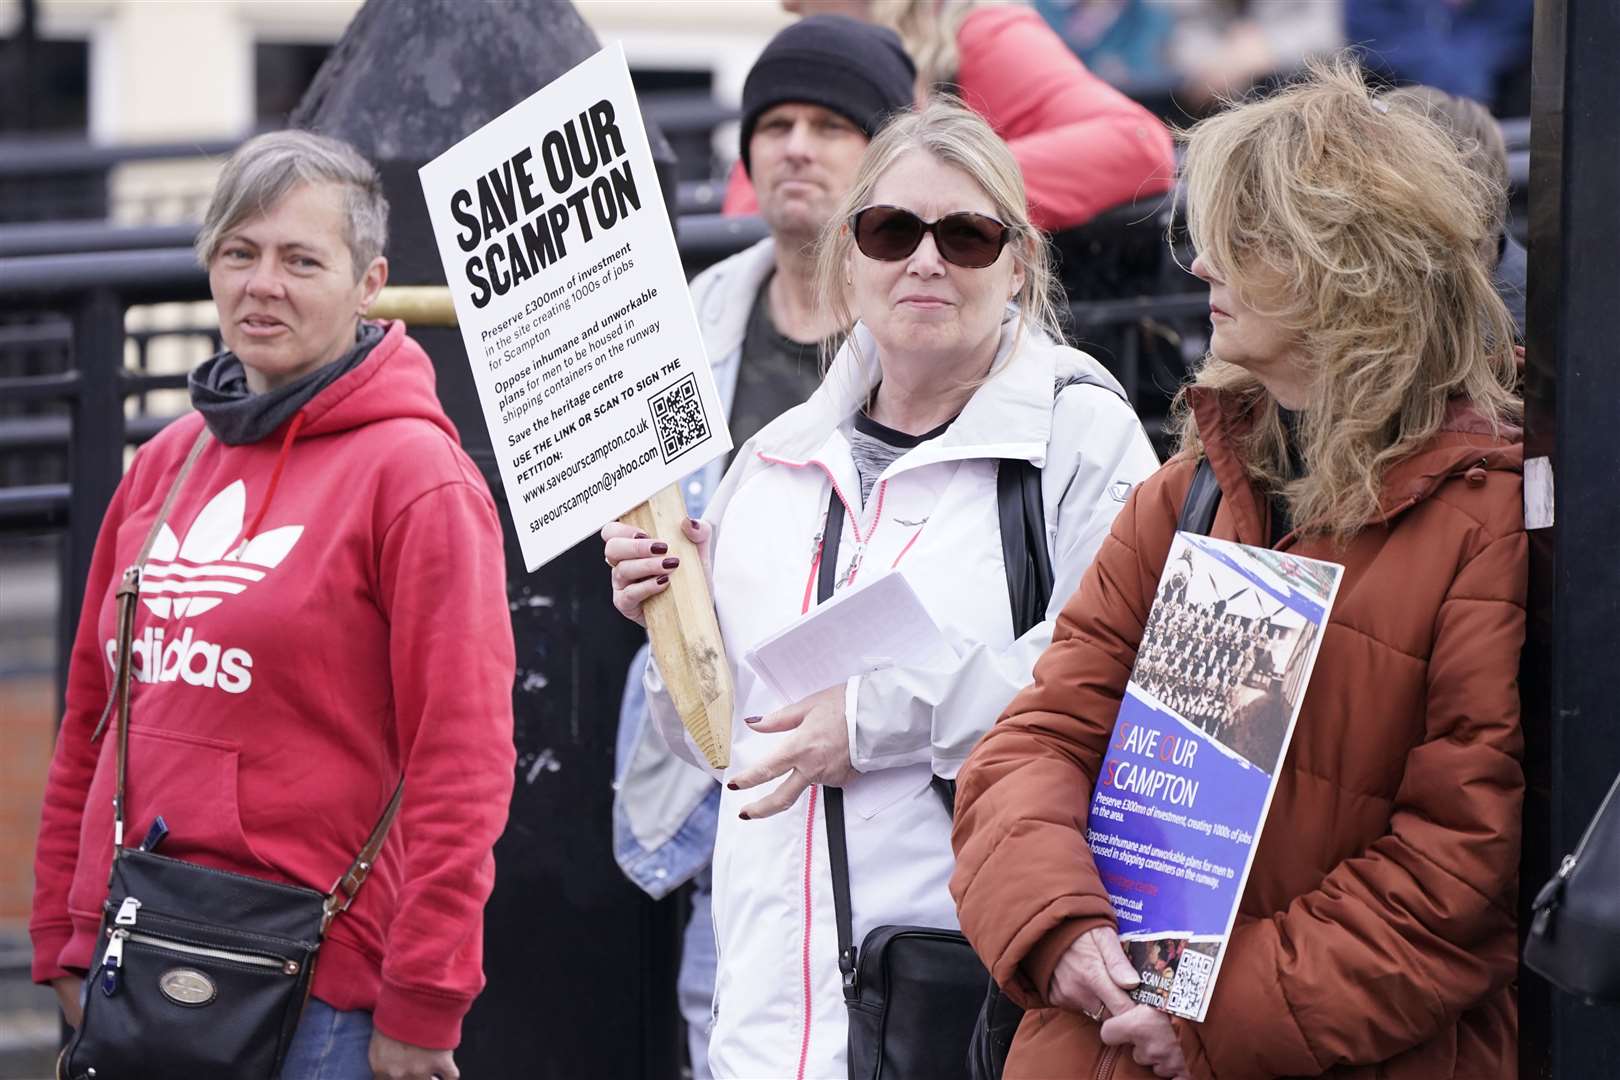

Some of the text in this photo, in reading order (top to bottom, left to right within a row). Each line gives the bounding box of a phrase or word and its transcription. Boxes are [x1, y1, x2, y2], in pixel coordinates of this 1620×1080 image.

[451, 99, 626, 252] SAVE OUR
[466, 160, 641, 308] SCAMPTON
[481, 242, 632, 342] Preserve £300mn of investment
[484, 260, 634, 358] in the site creating 1000s of jobs
[489, 328, 550, 372] for Scampton
[494, 288, 658, 394] Oppose inhumane and unworkable
[499, 320, 635, 412] plans for men to be housed in
[502, 320, 660, 424] shipping containers on the runway
[508, 370, 624, 447] Save the heritage centre
[512, 358, 681, 468] USE THE LINK OR SCAN TO SIGN THE
[517, 450, 563, 485] PETITION:
[522, 418, 650, 504] www.saveourscampton.co.uk
[530, 446, 660, 533] saveourscampton@yahoo.com
[1113, 720, 1198, 768] SAVE OUR
[1092, 804, 1099, 815] in
[1099, 806, 1110, 818] the
[1096, 792, 1122, 808] Preserve
[1121, 798, 1146, 815] £300mn
[1146, 806, 1156, 816] of
[1187, 818, 1212, 836] creating
[1212, 824, 1231, 838] 1000s
[1230, 828, 1240, 840] of
[1236, 831, 1252, 844] jobs
[1104, 759, 1200, 808] SCAMPTON
[1091, 840, 1114, 858] housed
[1112, 848, 1120, 860] in
[1119, 850, 1145, 870] shipping
[1145, 860, 1177, 877] containers
[1176, 868, 1186, 878] on
[1185, 868, 1197, 881] the
[1108, 834, 1139, 852] inhumane
[1138, 844, 1152, 855] and
[1151, 849, 1186, 865] unworkable
[1184, 856, 1203, 869] plans
[1203, 858, 1212, 872] for
[1212, 864, 1227, 877] men
[1226, 867, 1235, 879] to
[1138, 990, 1168, 1008] PETITION
[1140, 970, 1162, 988] SCAN
